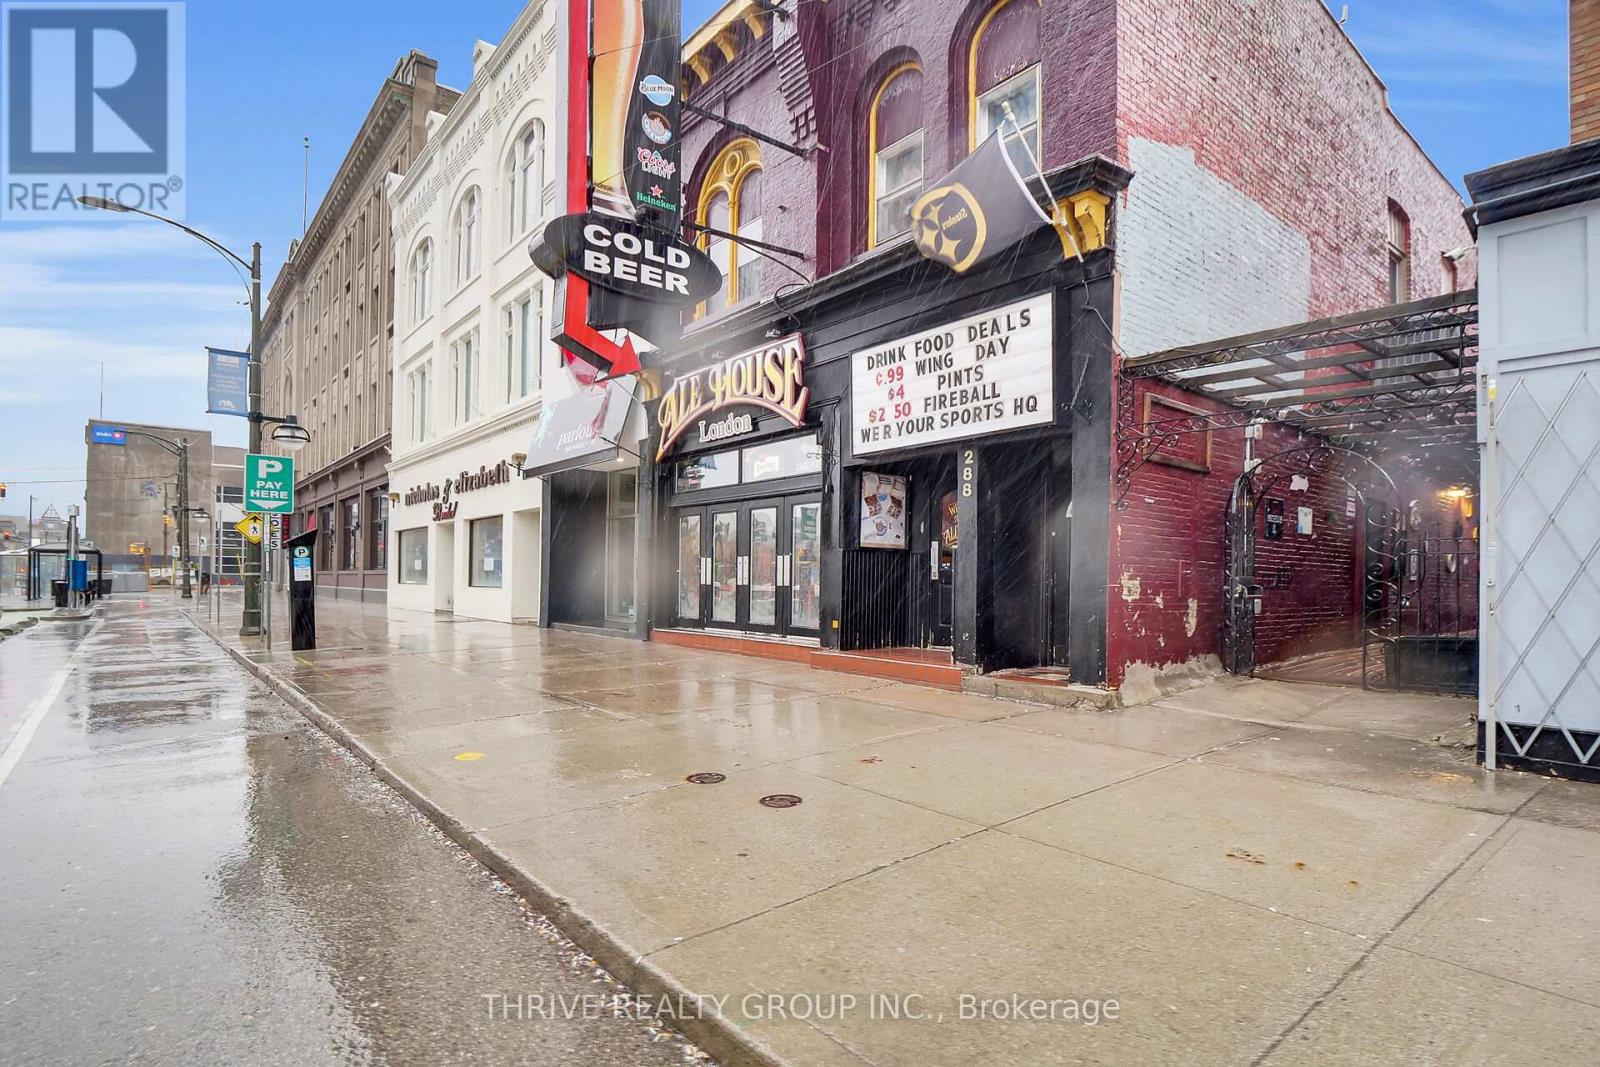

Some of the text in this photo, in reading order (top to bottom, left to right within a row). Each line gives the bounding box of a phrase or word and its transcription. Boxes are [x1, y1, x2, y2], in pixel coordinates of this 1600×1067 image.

[642, 161, 673, 180] LIGHT
[636, 192, 676, 212] Heineken
[583, 224, 691, 269] COLD
[584, 249, 690, 296] BEER
[867, 308, 1031, 371] DRINK FOOD DEALS
[915, 352, 954, 376] WING
[975, 336, 1010, 361] DAY
[657, 341, 807, 441] ALE HOUSE
[888, 365, 984, 401] $4 PINTS
[924, 382, 1001, 413] FIREBALL
[699, 412, 753, 443] London
[896, 415, 934, 437] YOUR
[940, 401, 1004, 429] SPORTS
[1013, 395, 1038, 416] HQ
[256, 480, 283, 490] PAY
[258, 459, 283, 479] P
[250, 489, 289, 499] HERE
